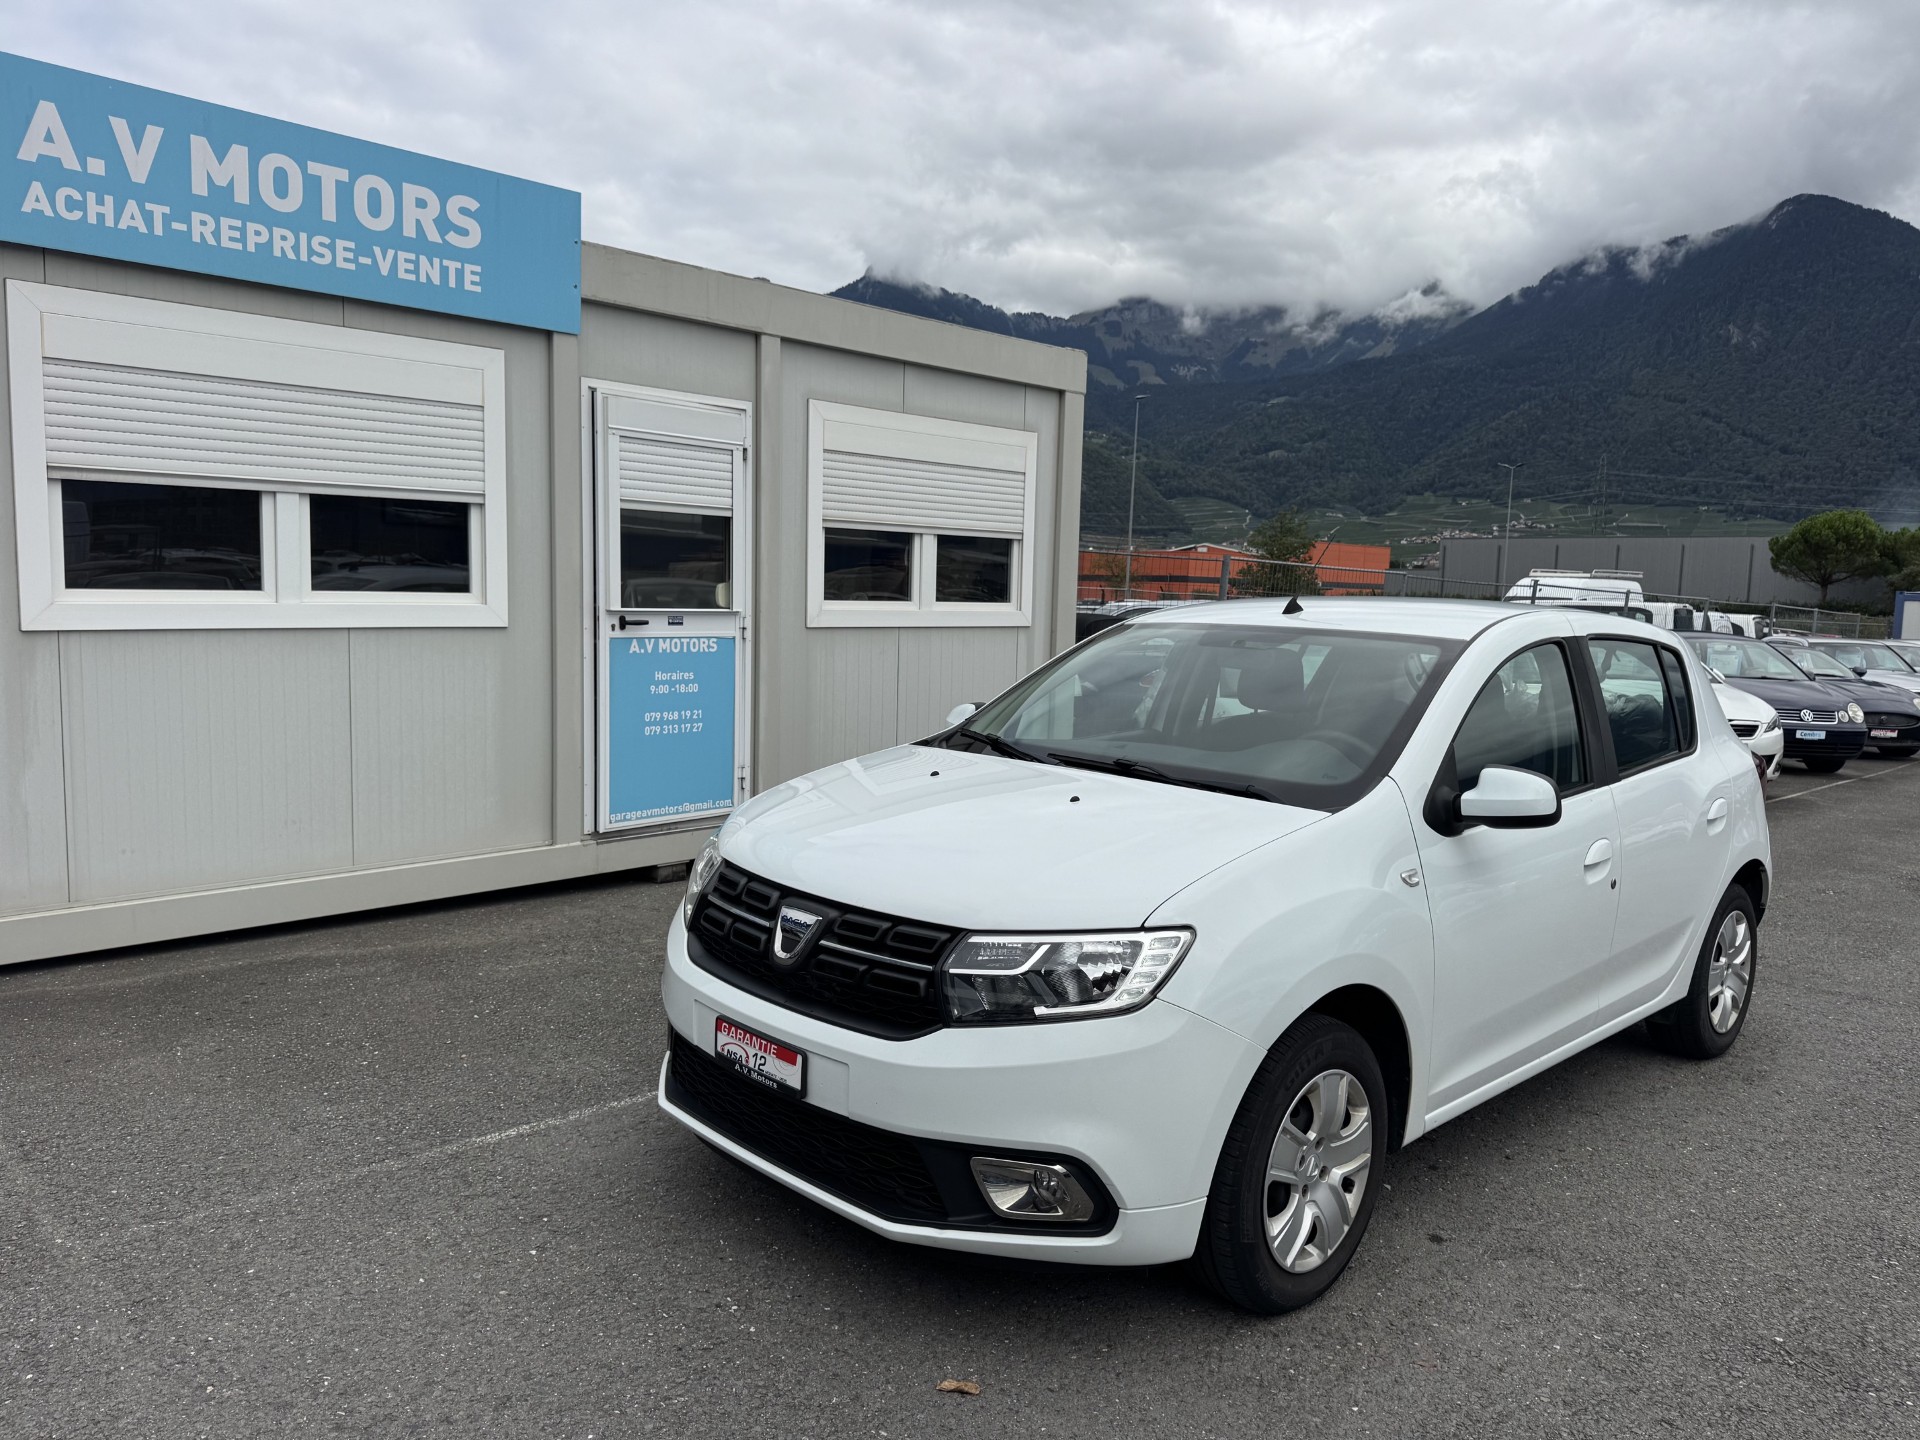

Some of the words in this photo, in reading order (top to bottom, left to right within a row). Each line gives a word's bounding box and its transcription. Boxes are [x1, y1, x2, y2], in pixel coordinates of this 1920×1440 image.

[17, 100, 164, 184] A.V
[190, 134, 482, 249] MOTORS
[21, 181, 482, 293] ACHAT-REPRISE-VENTE
[629, 638, 655, 653] A.V
[659, 637, 718, 653] MOTORS
[655, 670, 694, 680] Horaires
[650, 684, 669, 694] 9:00
[645, 712, 661, 722] 079
[662, 711, 679, 720] 968
[681, 710, 691, 720] 19
[692, 709, 702, 719] 21
[645, 725, 661, 736] 079
[662, 724, 679, 734] 313
[681, 723, 691, 733] 17
[692, 722, 703, 732] 27
[609, 799, 733, 823] garageavmotors@gmail.com
[721, 1022, 778, 1058] GARANTIE
[726, 1048, 743, 1064] NSA
[752, 1052, 767, 1072] 12
[735, 1063, 750, 1075] A.V.
[750, 1071, 778, 1089] Motors
